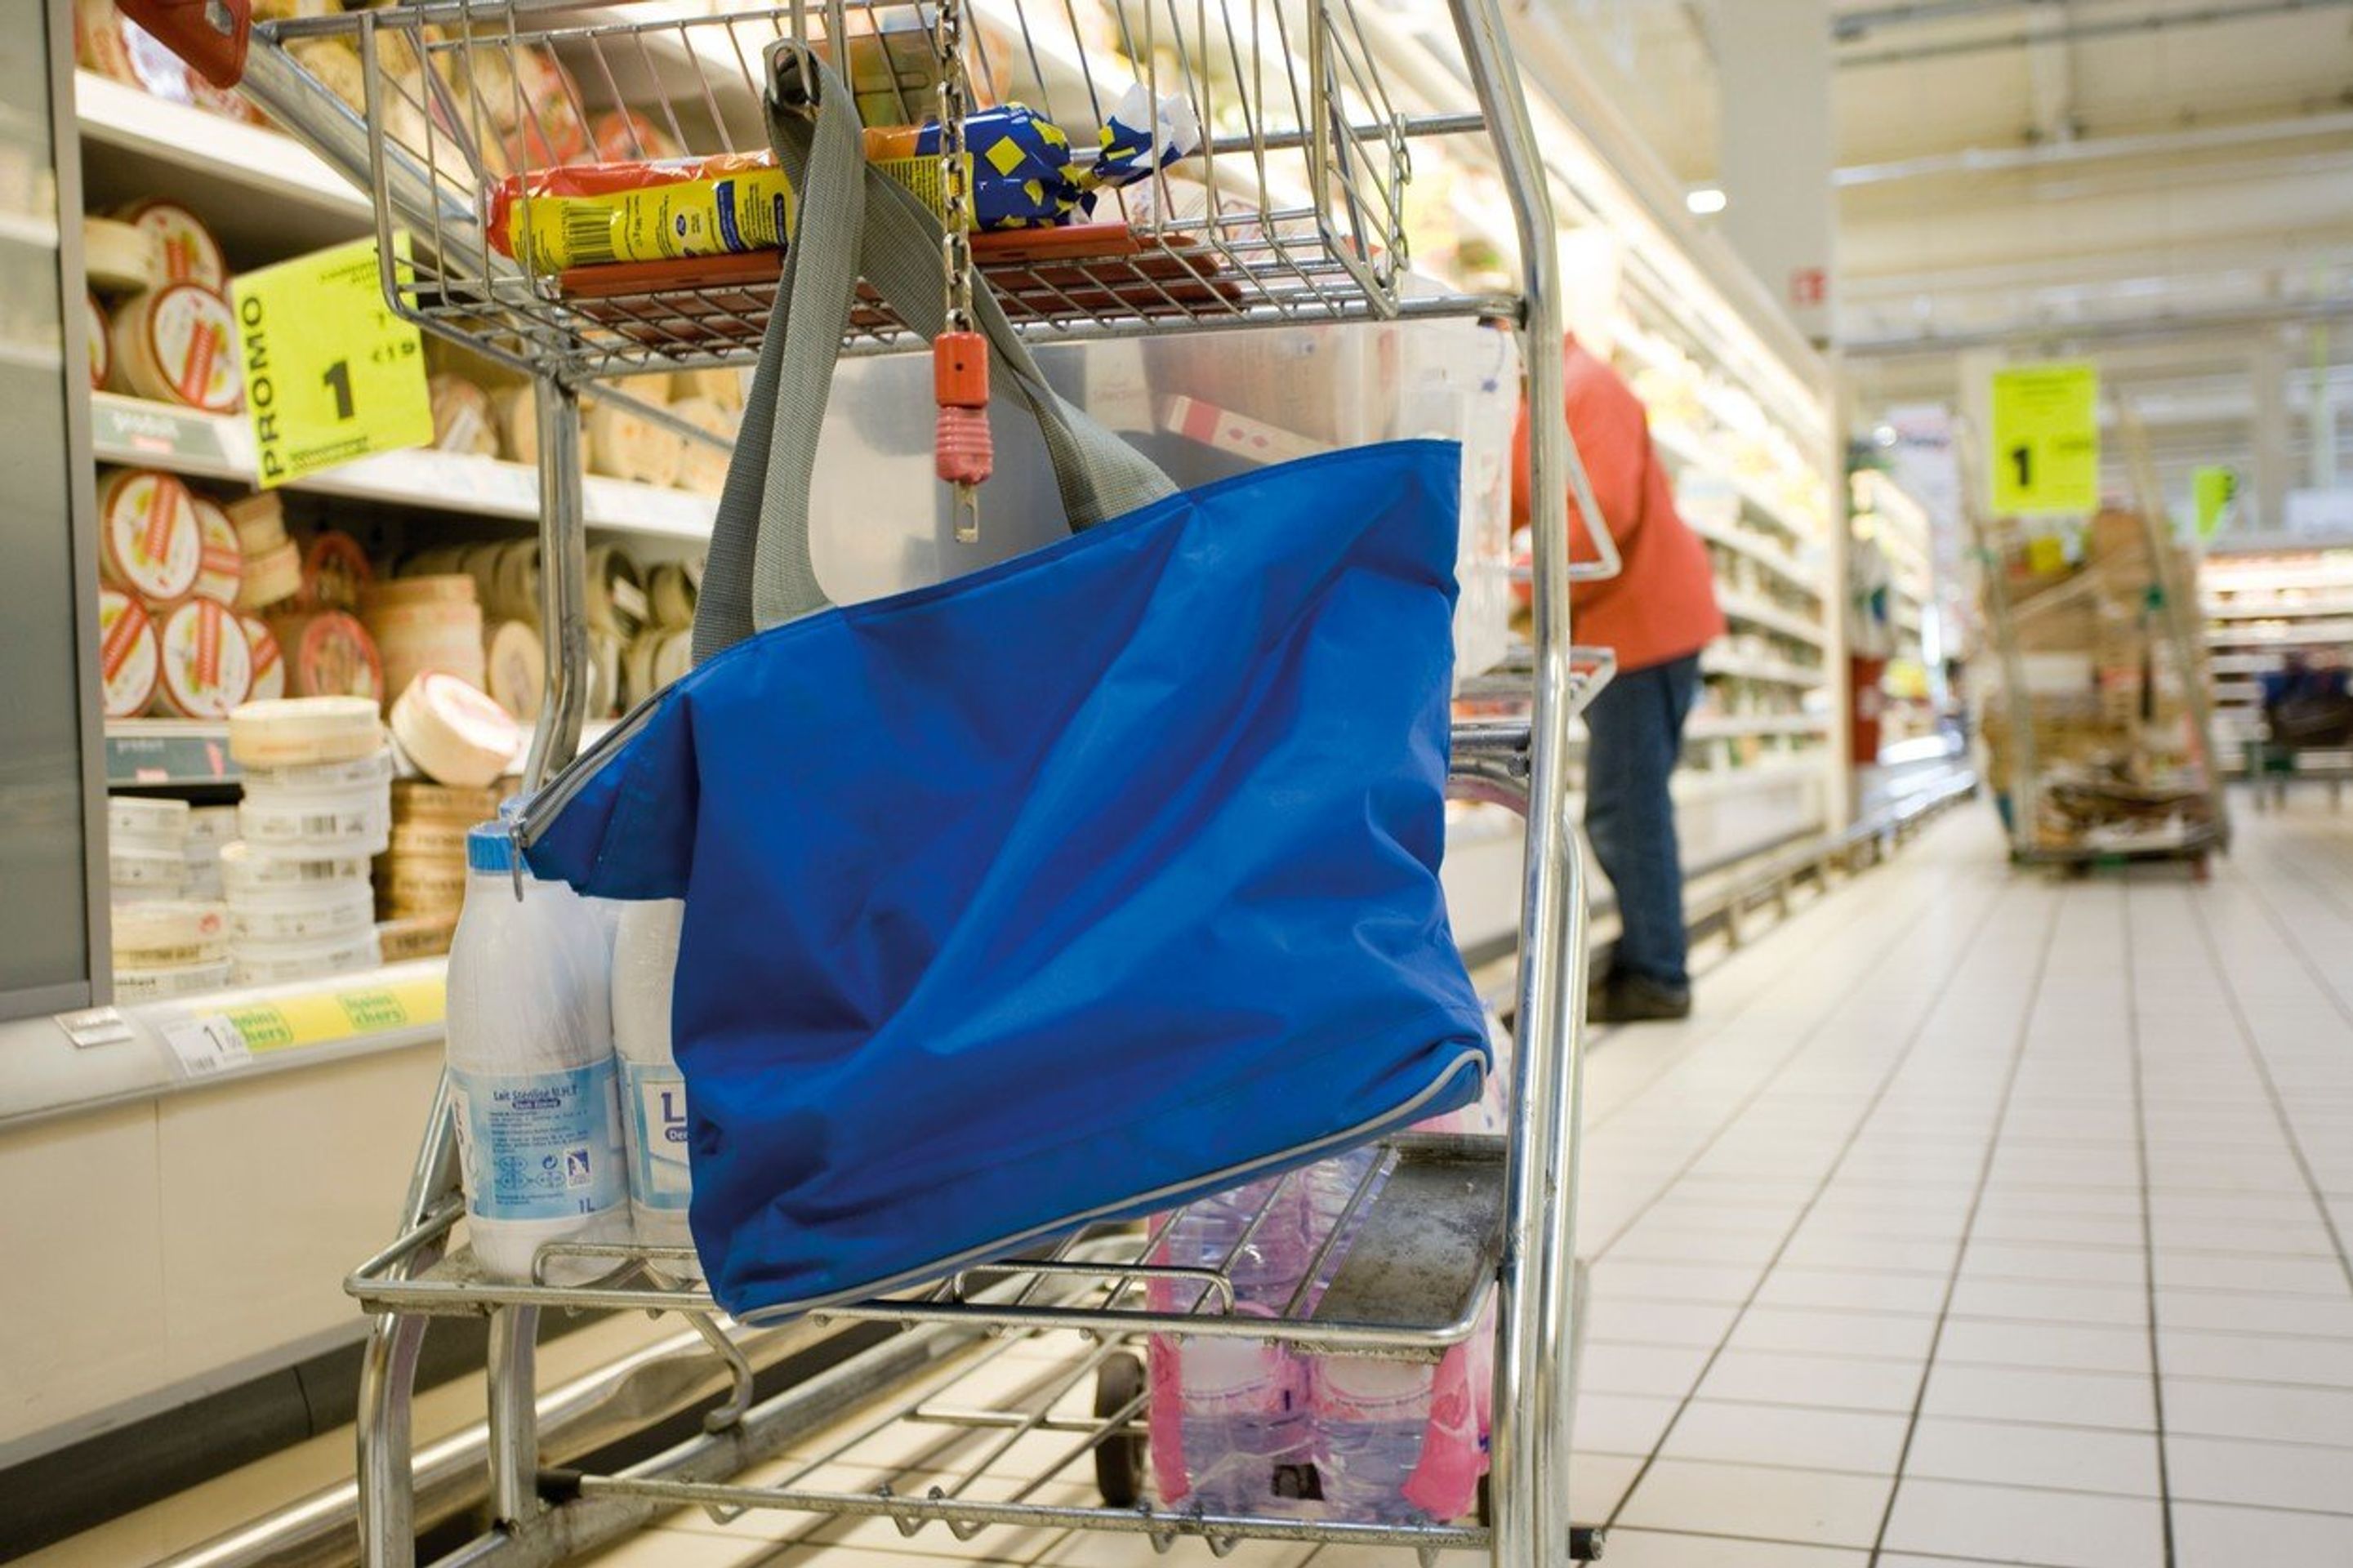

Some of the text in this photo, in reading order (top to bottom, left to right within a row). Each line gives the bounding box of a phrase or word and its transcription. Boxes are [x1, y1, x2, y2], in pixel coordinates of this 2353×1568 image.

[242, 296, 284, 479] PROMO
[323, 359, 355, 421] 1
[2012, 446, 2031, 488] 1
